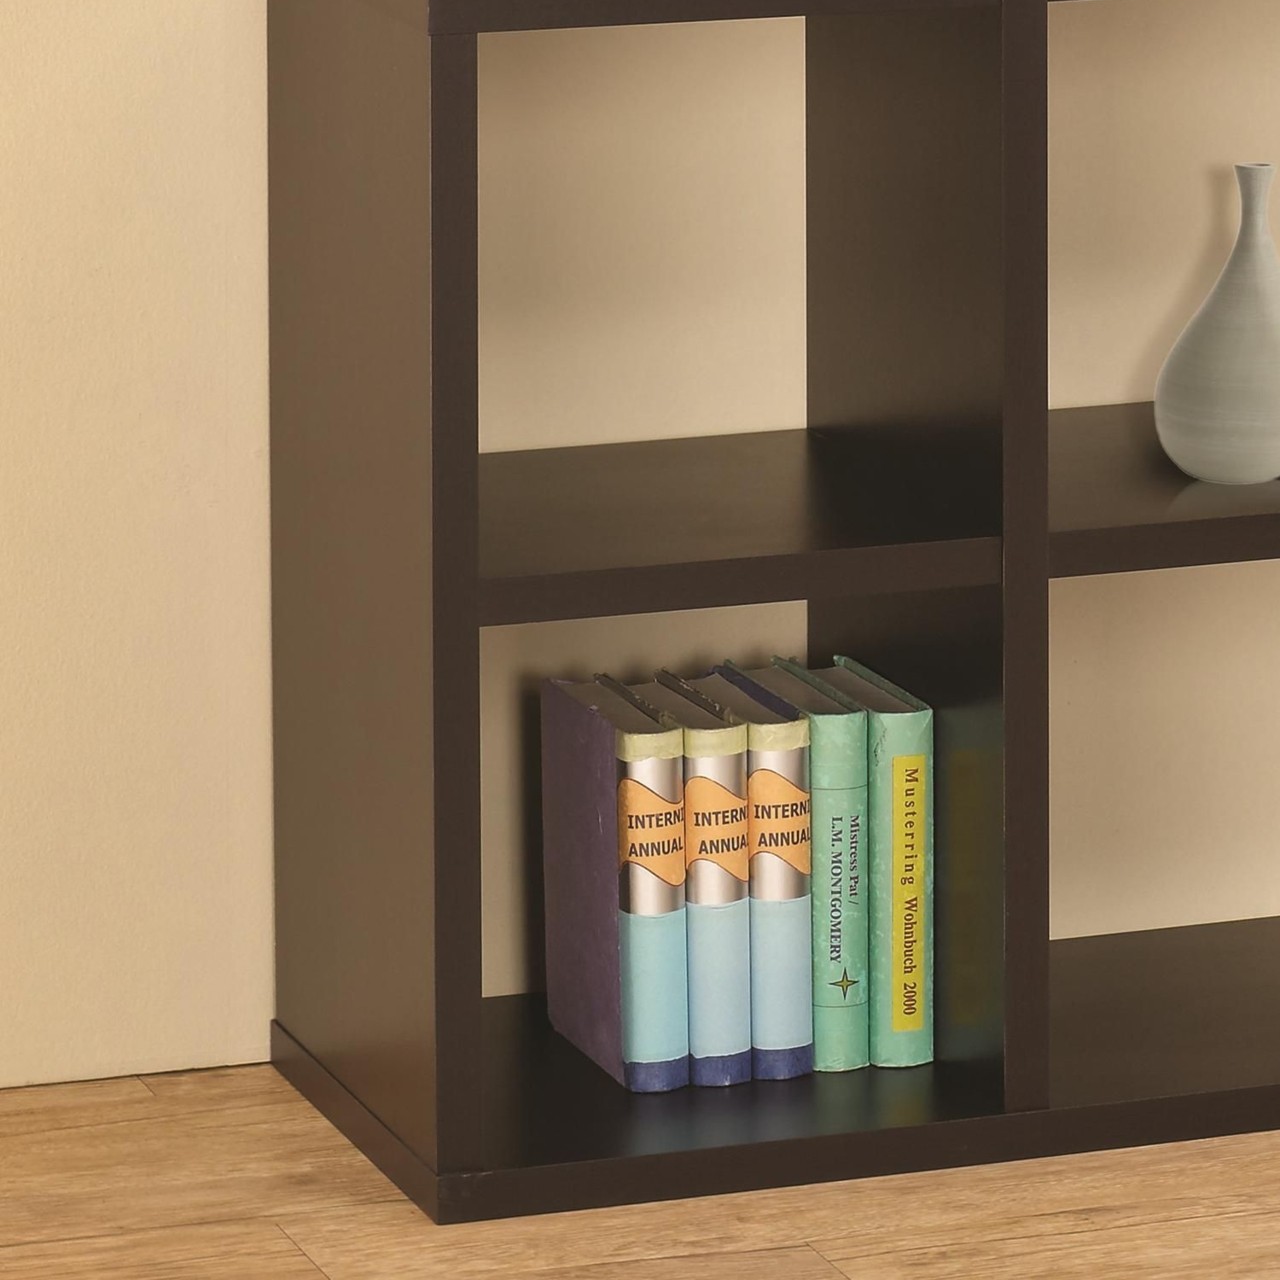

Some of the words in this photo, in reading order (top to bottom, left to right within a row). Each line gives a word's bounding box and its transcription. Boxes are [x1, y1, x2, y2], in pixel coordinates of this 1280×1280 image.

[628, 836, 683, 857] ANNUAL
[849, 815, 861, 872] Mistress
[900, 768, 919, 885] Musterring
[829, 851, 843, 964] MONTGOMERY
[848, 875, 859, 897] Pat
[903, 896, 918, 975] Wohnbuch
[902, 982, 917, 1015] 2000
